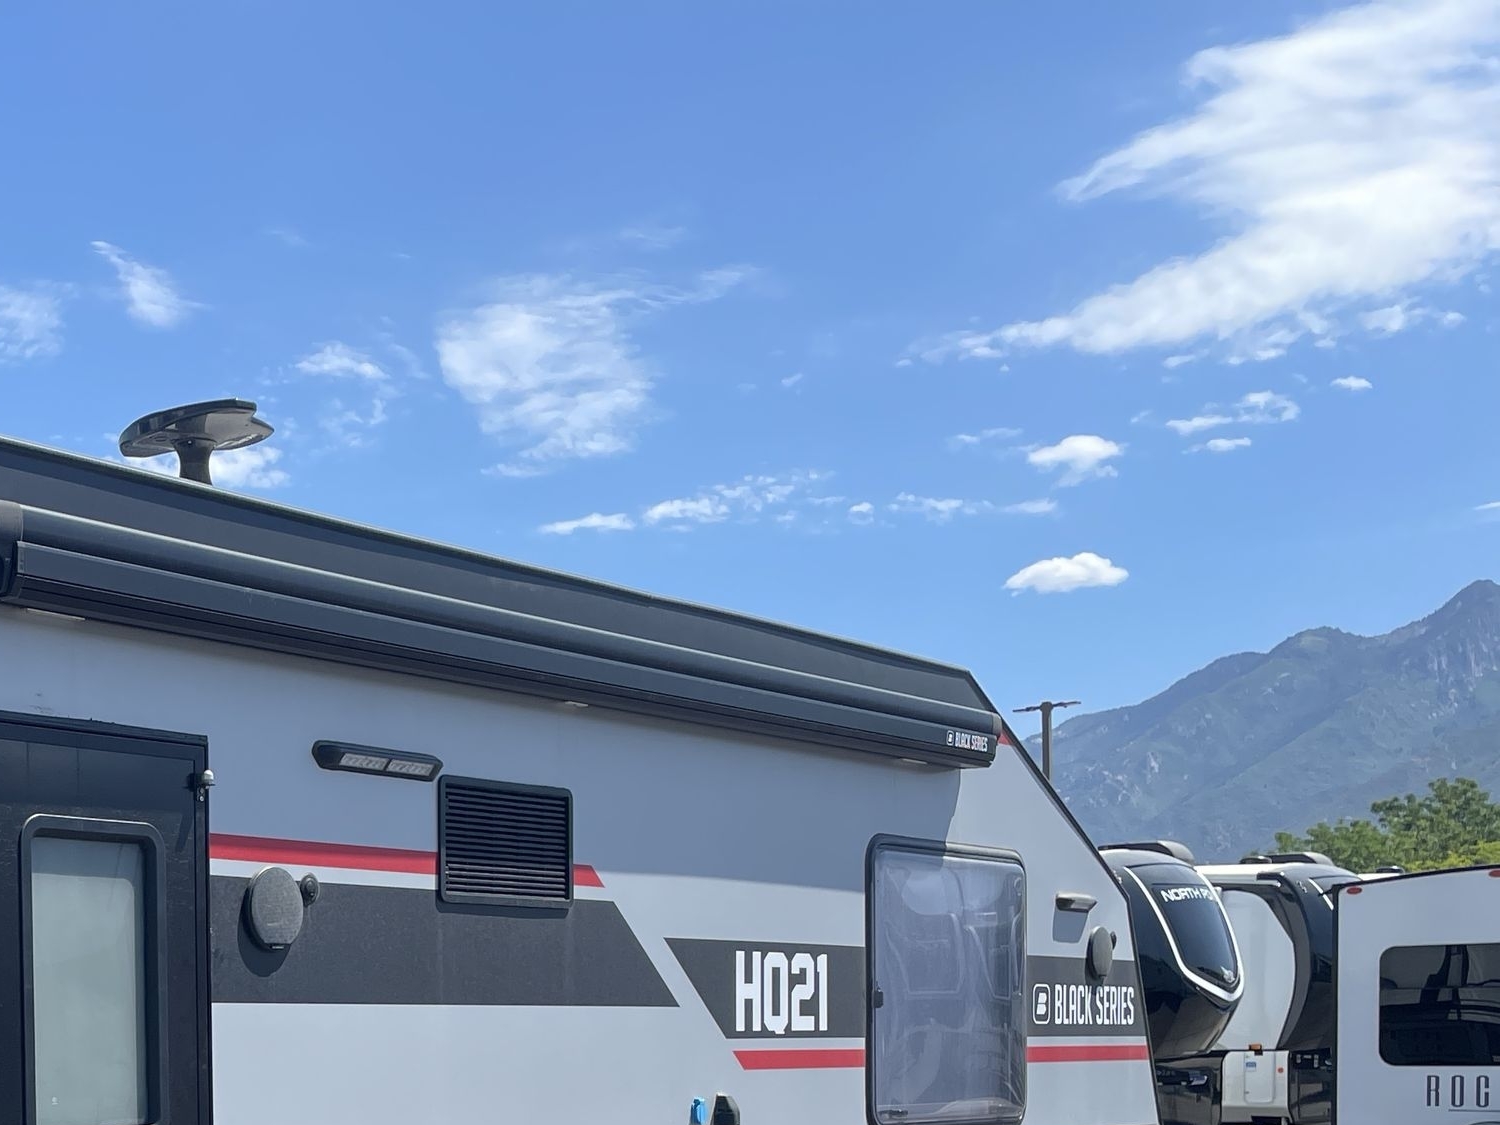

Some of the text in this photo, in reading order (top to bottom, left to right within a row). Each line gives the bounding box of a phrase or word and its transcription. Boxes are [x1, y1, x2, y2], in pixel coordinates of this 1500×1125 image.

[1161, 887, 1201, 902] NORTH
[735, 950, 828, 1034] HQ21
[1054, 984, 1092, 1025] BLACK
[1096, 986, 1135, 1025] SERIES
[1426, 1074, 1490, 1108] ROC
